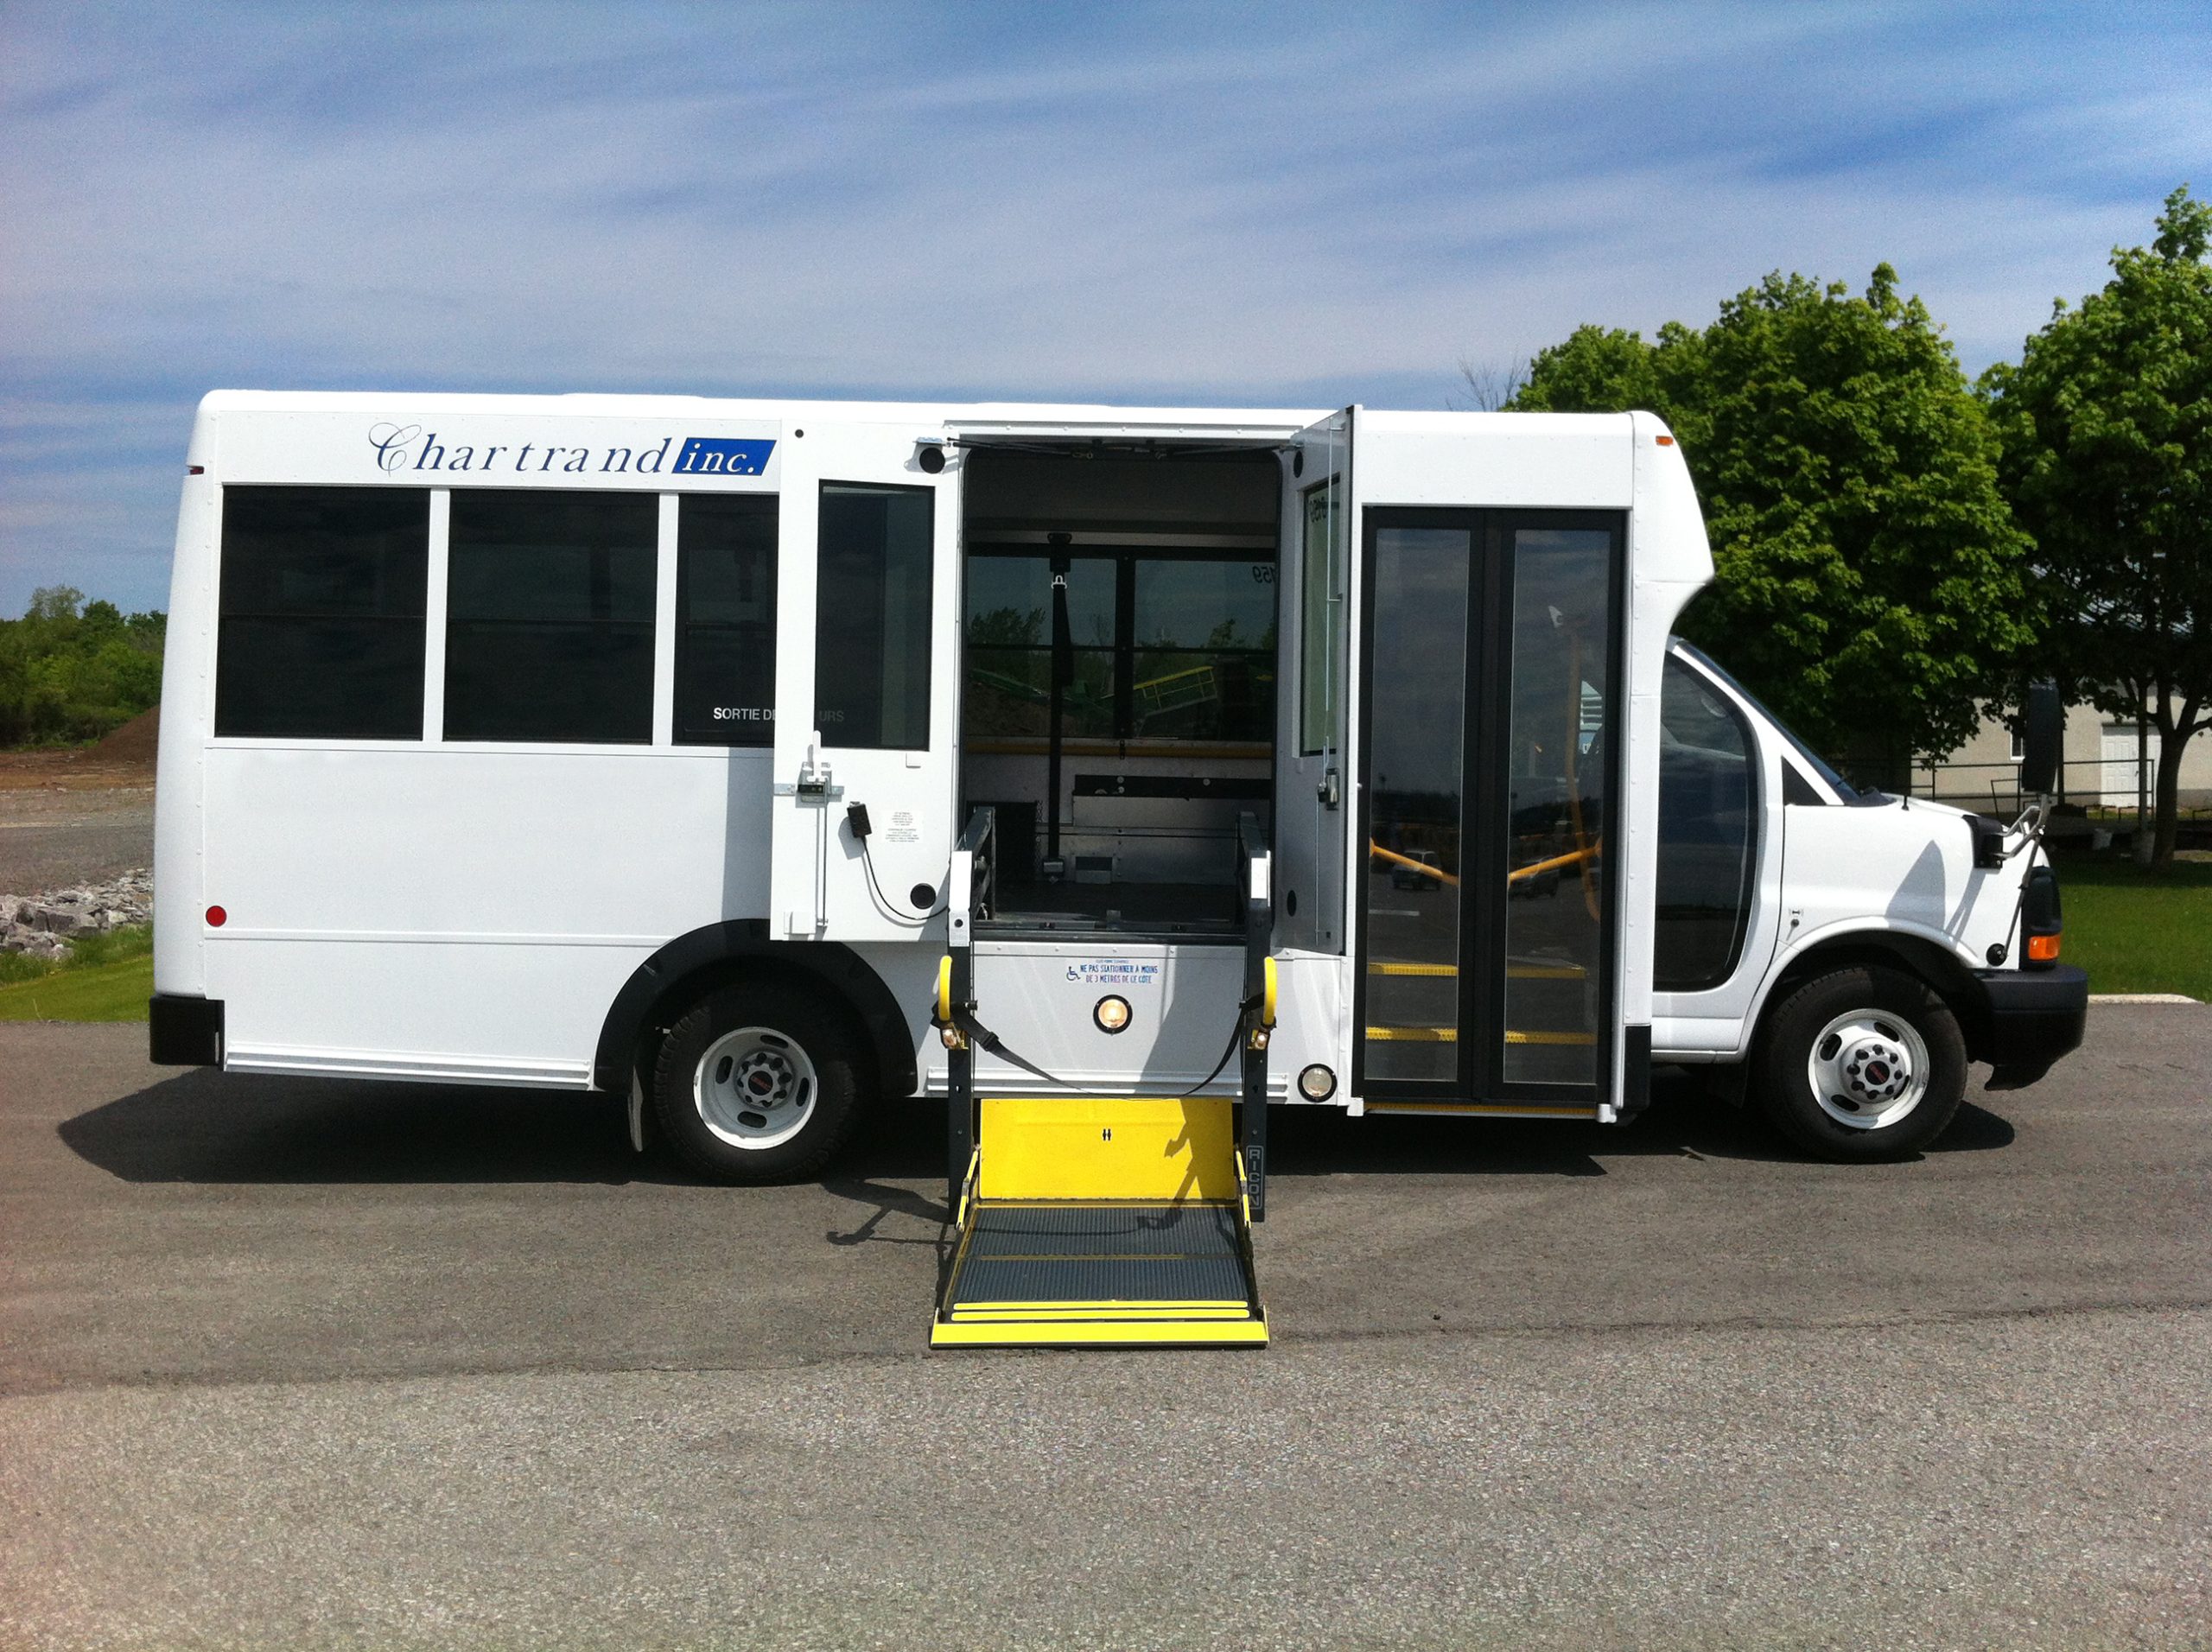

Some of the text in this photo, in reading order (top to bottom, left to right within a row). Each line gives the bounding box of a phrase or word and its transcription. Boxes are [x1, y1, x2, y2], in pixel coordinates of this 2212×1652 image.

[368, 421, 756, 477] Chartrand inc.
[713, 707, 760, 721] SORTIE
[1089, 964, 1098, 973] PAS
[1249, 1149, 1261, 1205] RICON
